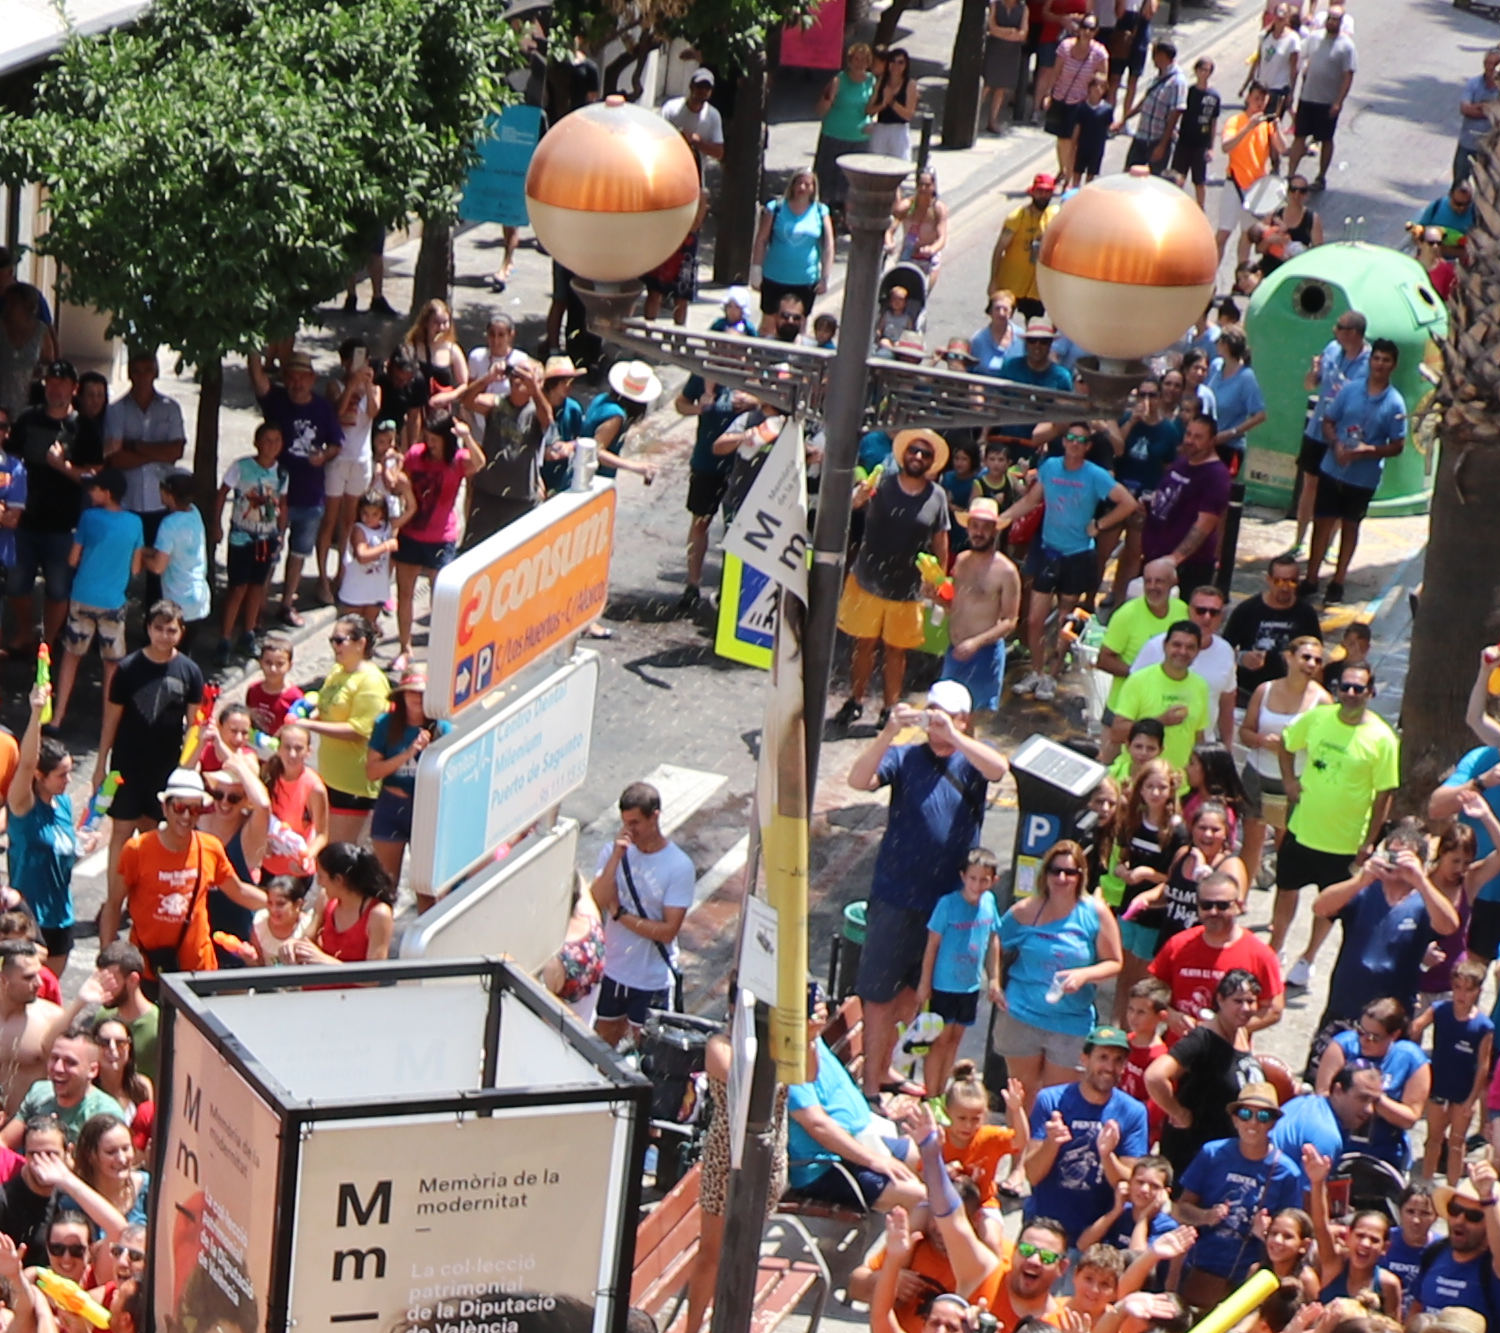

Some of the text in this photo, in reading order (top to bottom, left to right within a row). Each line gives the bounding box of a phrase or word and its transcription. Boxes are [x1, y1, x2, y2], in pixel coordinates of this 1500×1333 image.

[743, 511, 782, 554] M
[491, 506, 609, 622] consum
[475, 647, 491, 691] P
[491, 775, 525, 809] Puerto
[526, 761, 541, 784] de
[1028, 815, 1050, 847] P
[184, 1073, 201, 1132] M
[176, 1138, 199, 1184] m
[418, 1169, 560, 1195] Memòria de la
[335, 1180, 392, 1228] M
[416, 1192, 528, 1215] modernitat
[332, 1245, 387, 1281] m
[411, 1261, 434, 1279] La
[409, 1275, 523, 1299] patrimonial
[406, 1294, 557, 1322] de la Diputació
